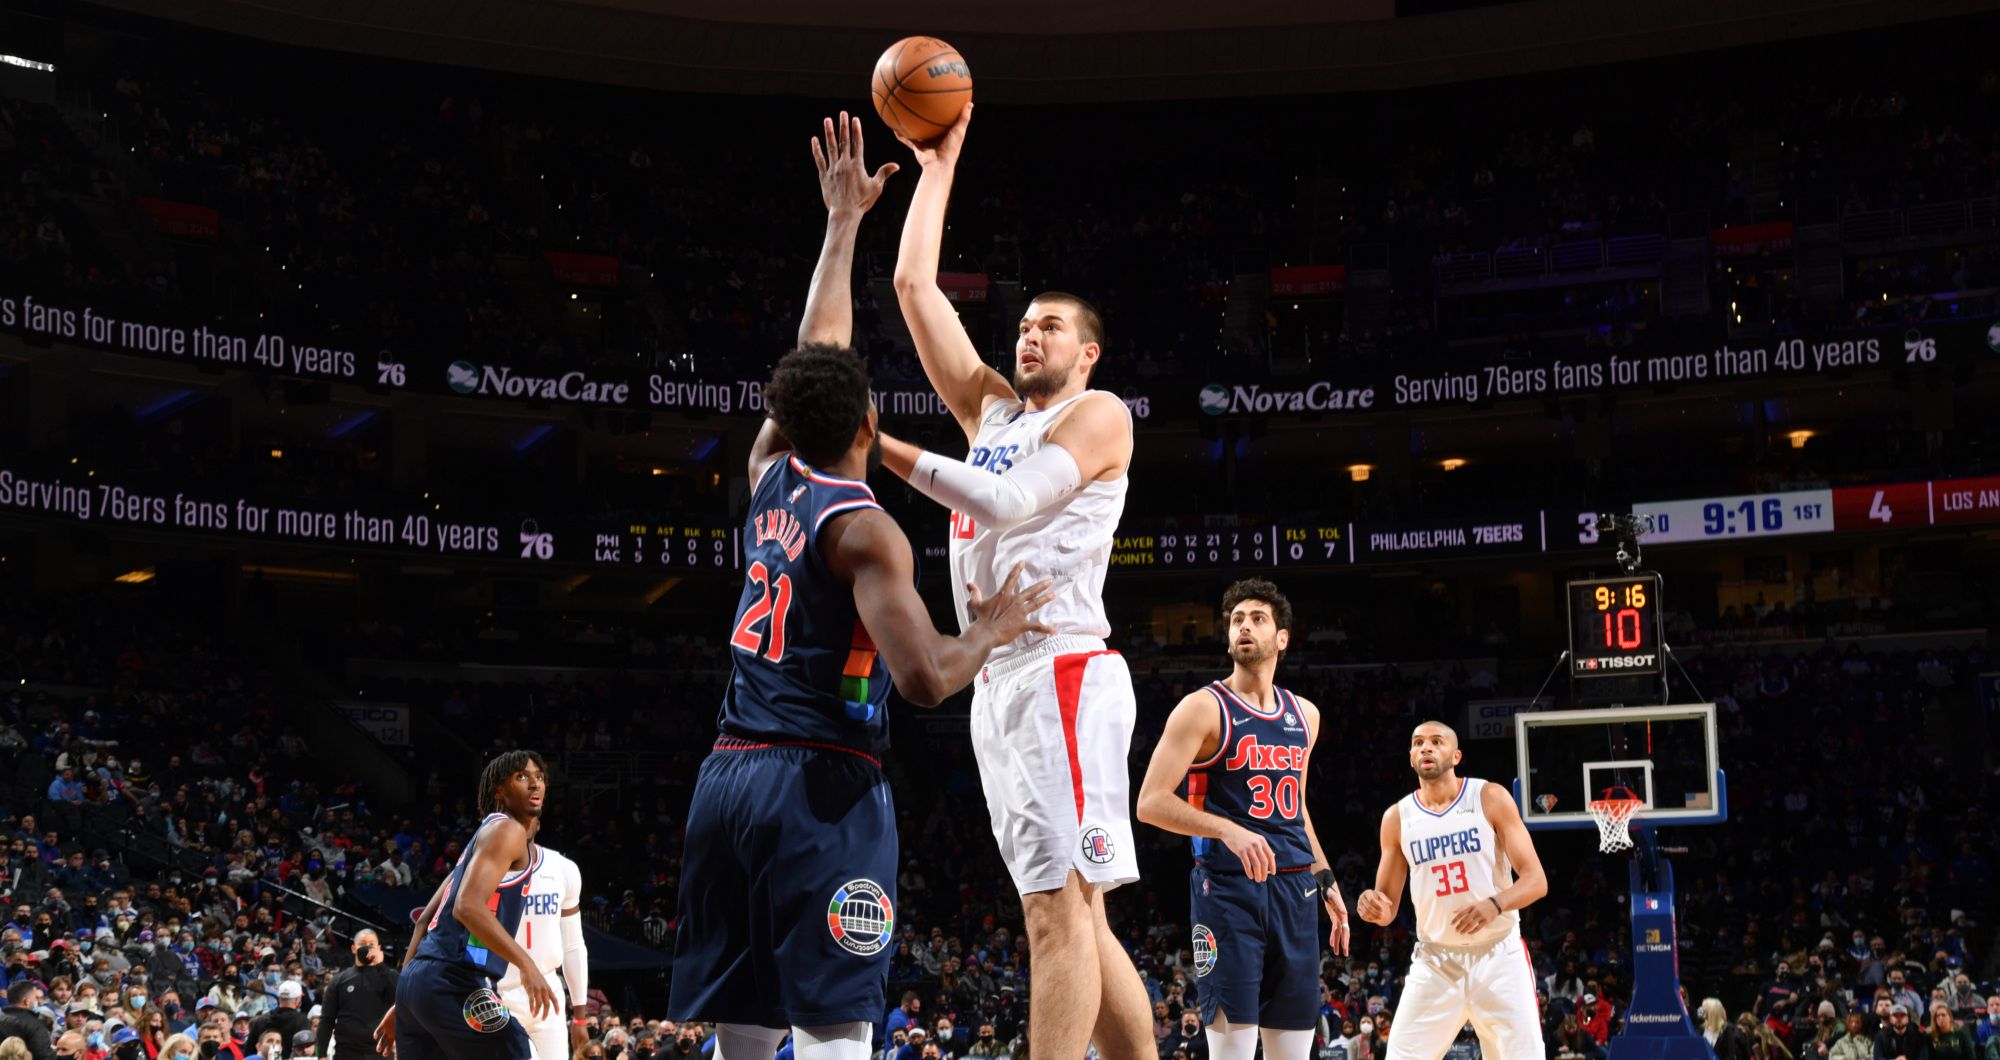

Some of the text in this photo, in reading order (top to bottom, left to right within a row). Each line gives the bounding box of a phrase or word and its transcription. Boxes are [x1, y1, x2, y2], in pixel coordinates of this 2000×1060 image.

[22, 295, 76, 337] fans
[81, 307, 115, 345] for
[121, 320, 186, 356] more
[191, 326, 247, 364] than
[253, 333, 285, 369] 40
[291, 343, 356, 378] years
[1904, 337, 1937, 363] 76
[376, 360, 407, 388] 76
[478, 364, 630, 405] NovaCare
[1394, 337, 1881, 405] Serving 76ers fans for more than 40 years
[648, 373, 732, 413] Serving
[1230, 381, 1376, 414] NovaCare
[0, 468, 500, 553] Serving 76ers fans for more than 40 years
[1793, 504, 1823, 520] 1ST
[1868, 490, 1893, 524] 4
[1943, 491, 1973, 512] LOS
[1703, 498, 1784, 535] 9:16
[519, 531, 555, 561] 76
[596, 533, 723, 552] PHI 1 1 0 0
[656, 525, 674, 537] AST
[684, 527, 701, 538] BLK
[710, 528, 727, 540] STL
[754, 508, 807, 562] EMBIID
[1160, 534, 1177, 548] 30
[1184, 534, 1198, 547] 12
[1206, 533, 1221, 546] 21
[1231, 533, 1239, 546] 7
[1253, 532, 1263, 545] 0
[1286, 527, 1341, 542] FLS TOL
[1370, 523, 1524, 551] PHILADELPHIA 76ERS
[594, 549, 724, 567] LAC 5 0 0 0
[1111, 549, 1263, 566] POINTS 0 0 0 3 0
[1290, 542, 1336, 560] 0 7
[1595, 583, 1646, 611] 9:16
[730, 560, 793, 664] 21
[1605, 608, 1641, 649] 10
[1598, 654, 1656, 668] TISSOT
[382, 727, 404, 742] 121
[1475, 722, 1502, 736] 120
[1226, 734, 1308, 771] Sixers
[1247, 775, 1299, 820] 30
[1410, 827, 1482, 866] CLIPPERS
[847, 882, 880, 897] Spectrum
[1431, 861, 1470, 897] 33
[843, 938, 880, 952] Spectrum
[1636, 944, 1671, 953] BETMGM
[1629, 1013, 1681, 1024] ticketmaster
